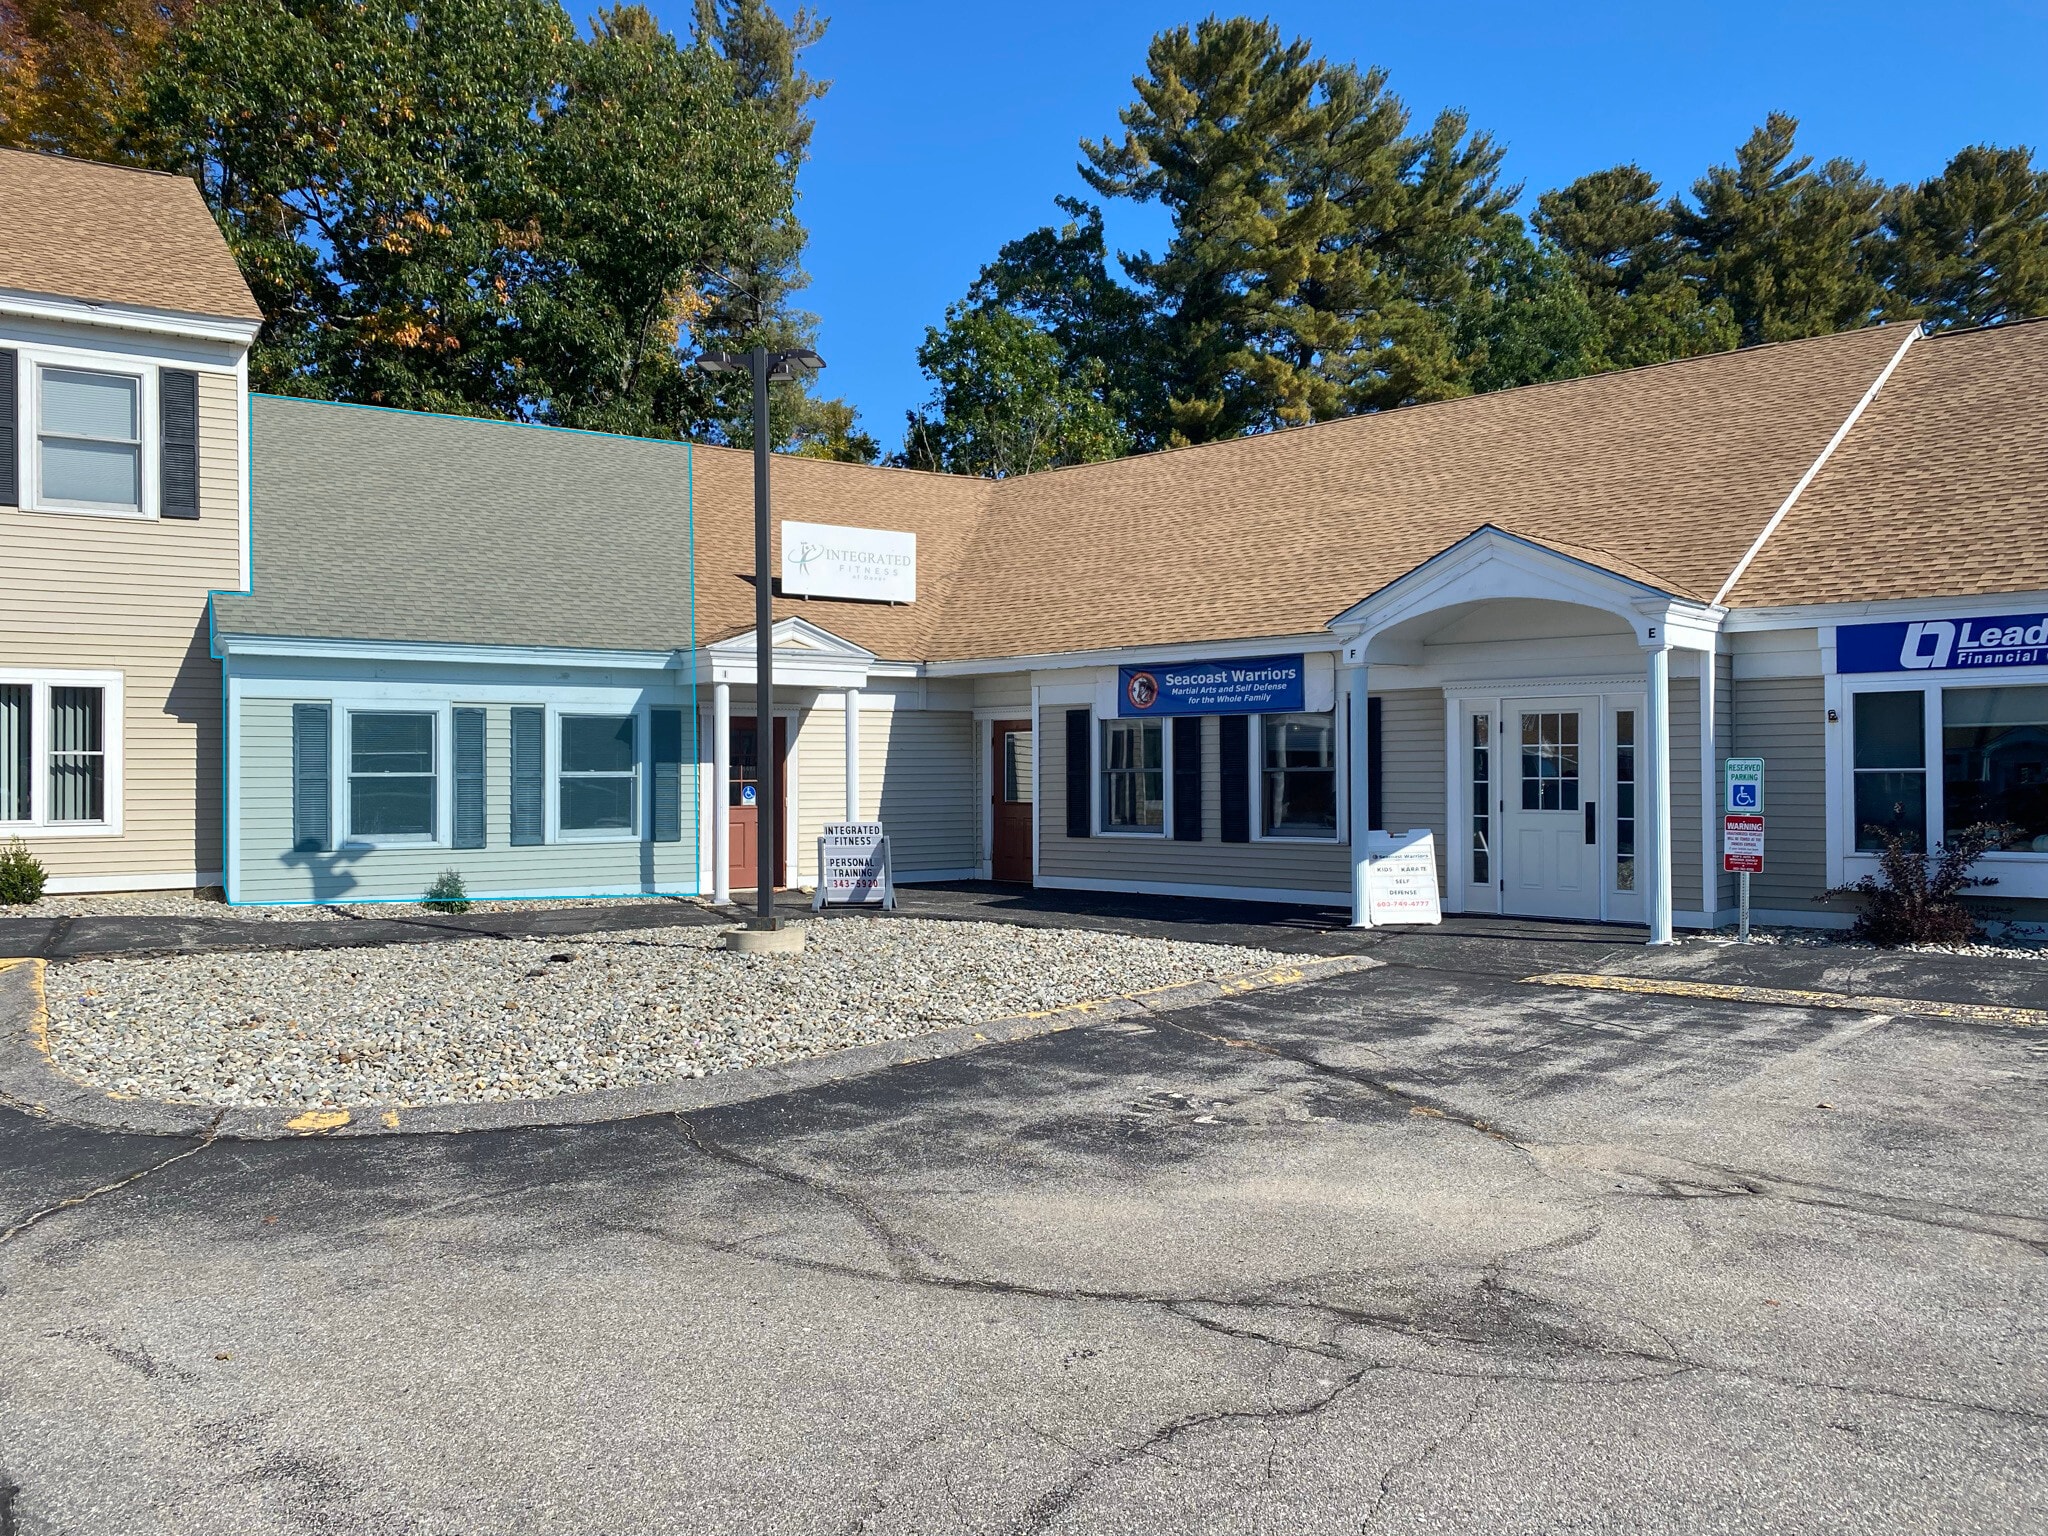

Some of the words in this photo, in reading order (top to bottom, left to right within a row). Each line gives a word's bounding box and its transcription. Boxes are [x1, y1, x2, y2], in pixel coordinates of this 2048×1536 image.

[826, 549, 911, 567] INTEGRATED
[839, 564, 898, 577] FITNESS
[1648, 627, 1656, 638] E
[1350, 649, 1356, 658] F
[1958, 649, 2038, 665] Financial
[1165, 671, 1227, 686] Seacoast
[1231, 668, 1296, 682] Warriors
[1171, 687, 1198, 696] Martial
[1200, 686, 1217, 694] Arts
[1218, 685, 1234, 693] and
[1235, 684, 1251, 692] Self
[1253, 682, 1287, 691] Defense
[1188, 696, 1200, 705] for
[1201, 695, 1215, 704] the
[1216, 694, 1242, 703] Whole
[1243, 693, 1271, 703] Family
[1728, 764, 1760, 772] RESERVED
[1731, 773, 1759, 781] PARKING
[825, 826, 880, 835] INTEGRATED
[1727, 822, 1762, 831] WARNING
[834, 836, 871, 845] FITNESS
[829, 858, 874, 867] PERSONAL
[833, 869, 873, 878] TRAINING
[833, 880, 878, 888] 343-5920
